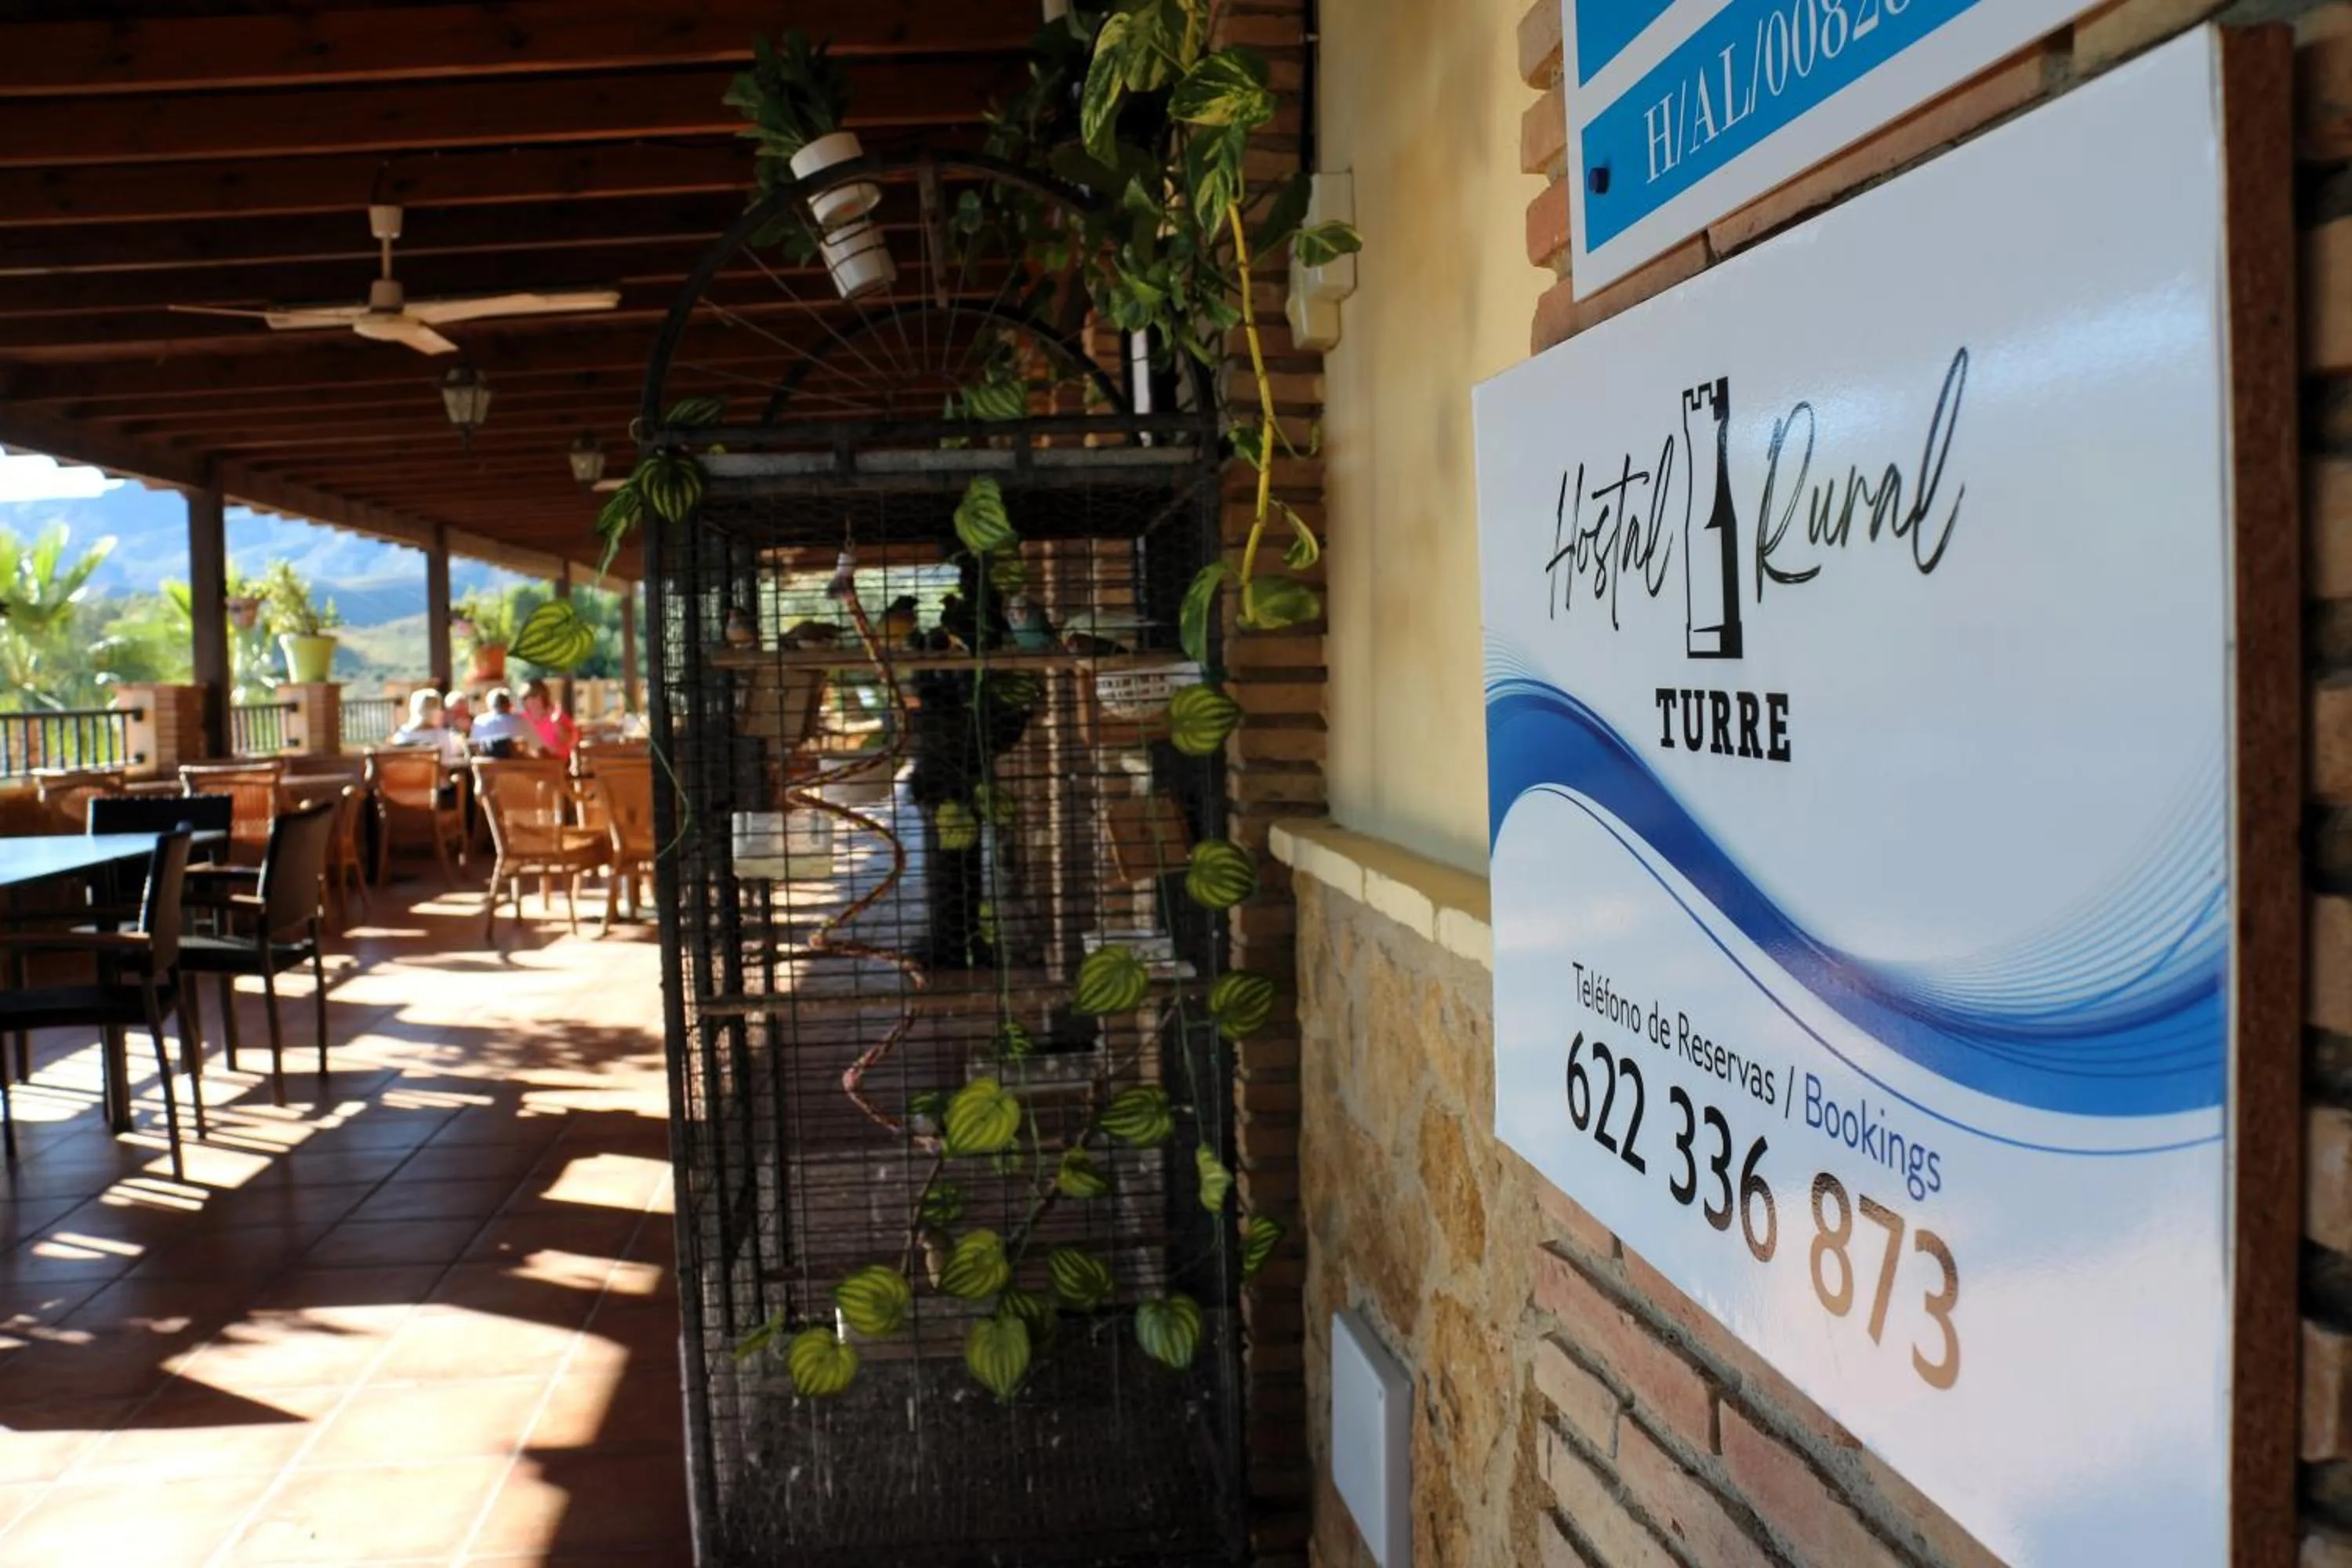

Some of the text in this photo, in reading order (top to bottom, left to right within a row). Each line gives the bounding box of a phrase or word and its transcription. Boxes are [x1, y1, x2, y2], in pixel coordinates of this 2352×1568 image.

[1644, 0, 1911, 183] H/AL/008
[1545, 346, 1968, 632] Hostal Rural
[1655, 687, 1791, 763] TURRE
[1572, 961, 1942, 1202] Teléfono de Reservas / Bookings
[1567, 1031, 1960, 1390] 622 336 873
